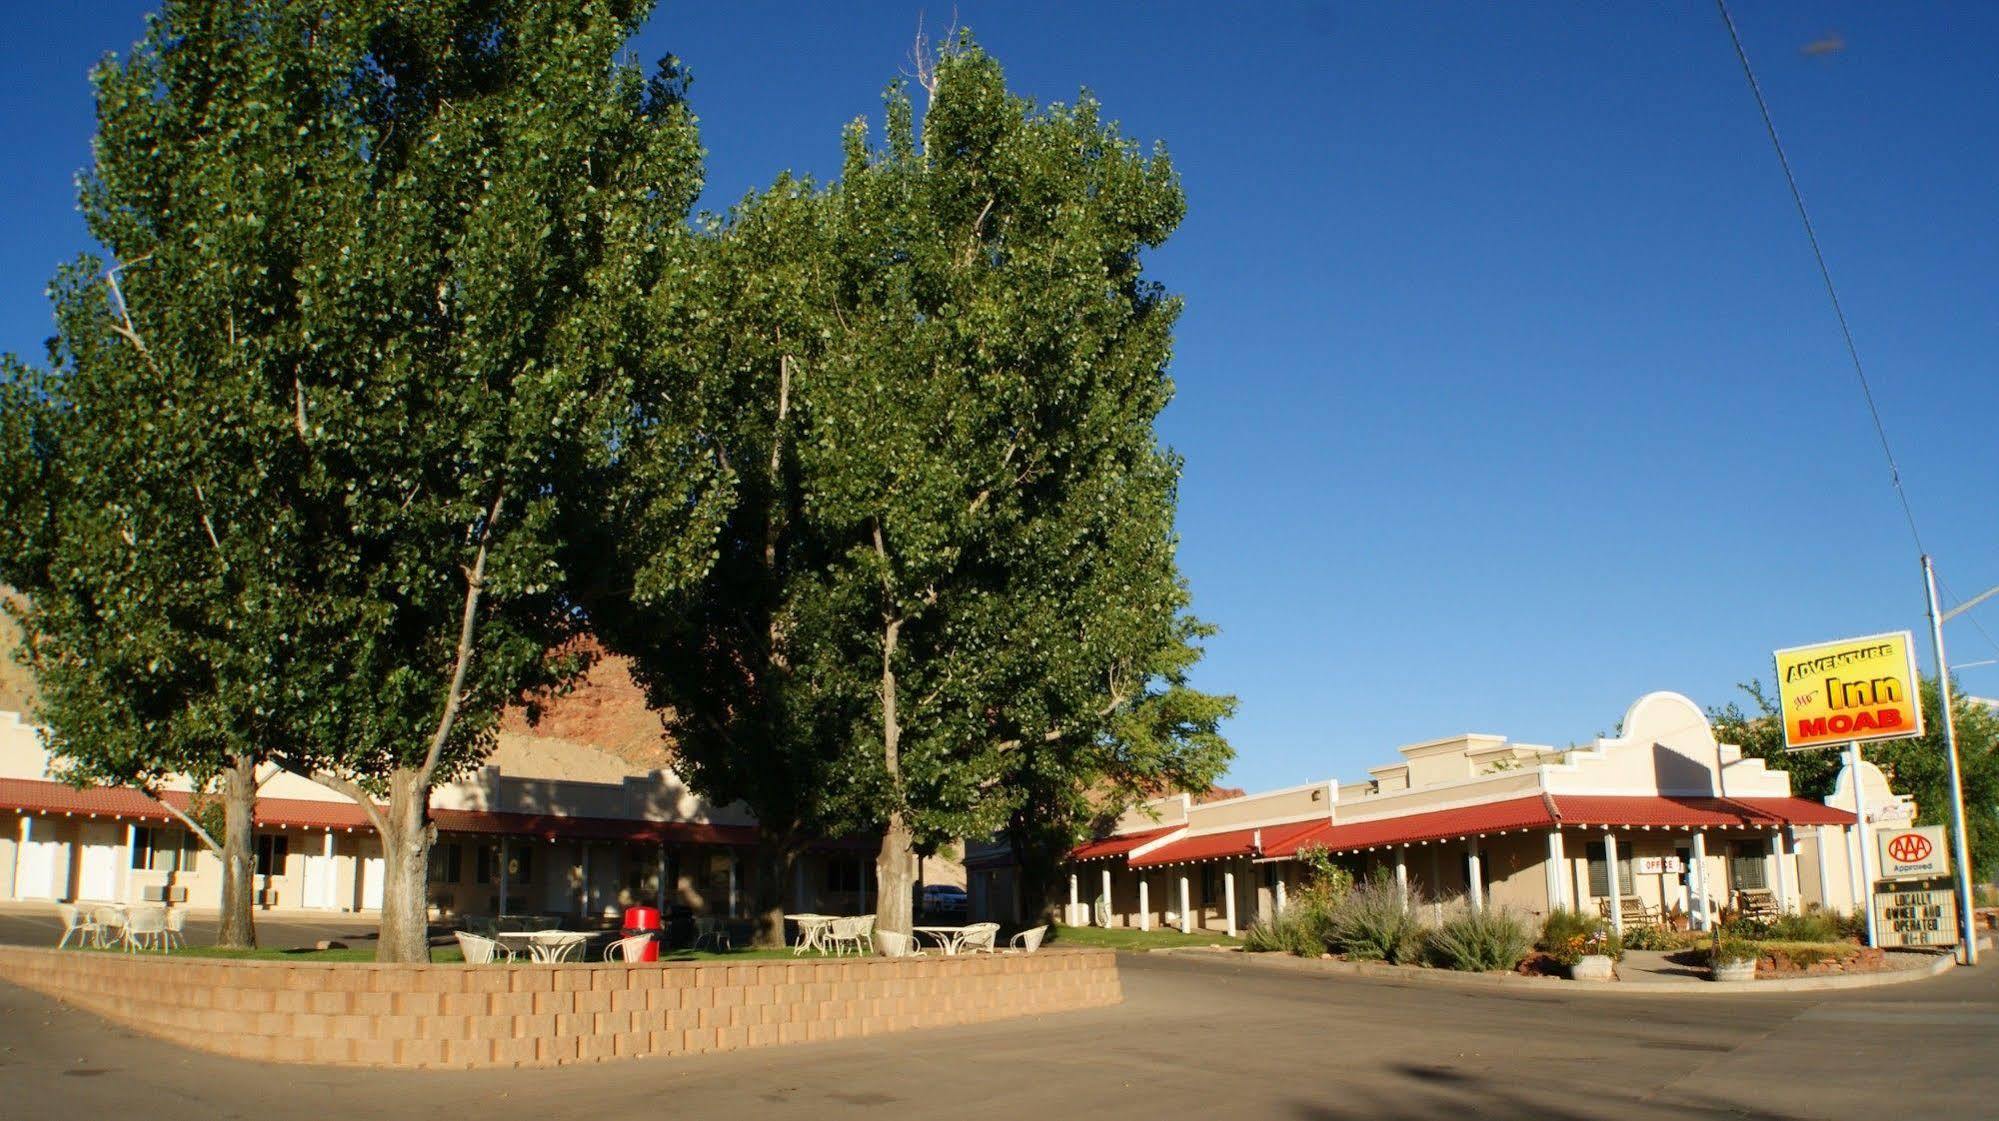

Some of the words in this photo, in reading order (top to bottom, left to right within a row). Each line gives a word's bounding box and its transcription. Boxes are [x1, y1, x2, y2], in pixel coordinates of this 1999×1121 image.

[1787, 644, 1893, 683] ADVENTURE
[1826, 676, 1902, 711] Inn
[1799, 708, 1903, 738] MOAB
[1891, 834, 1931, 862] AAA
[1894, 863, 1933, 873] Approved
[1895, 893, 1932, 906] LOCALLY
[1893, 918, 1938, 932] OPERATED
